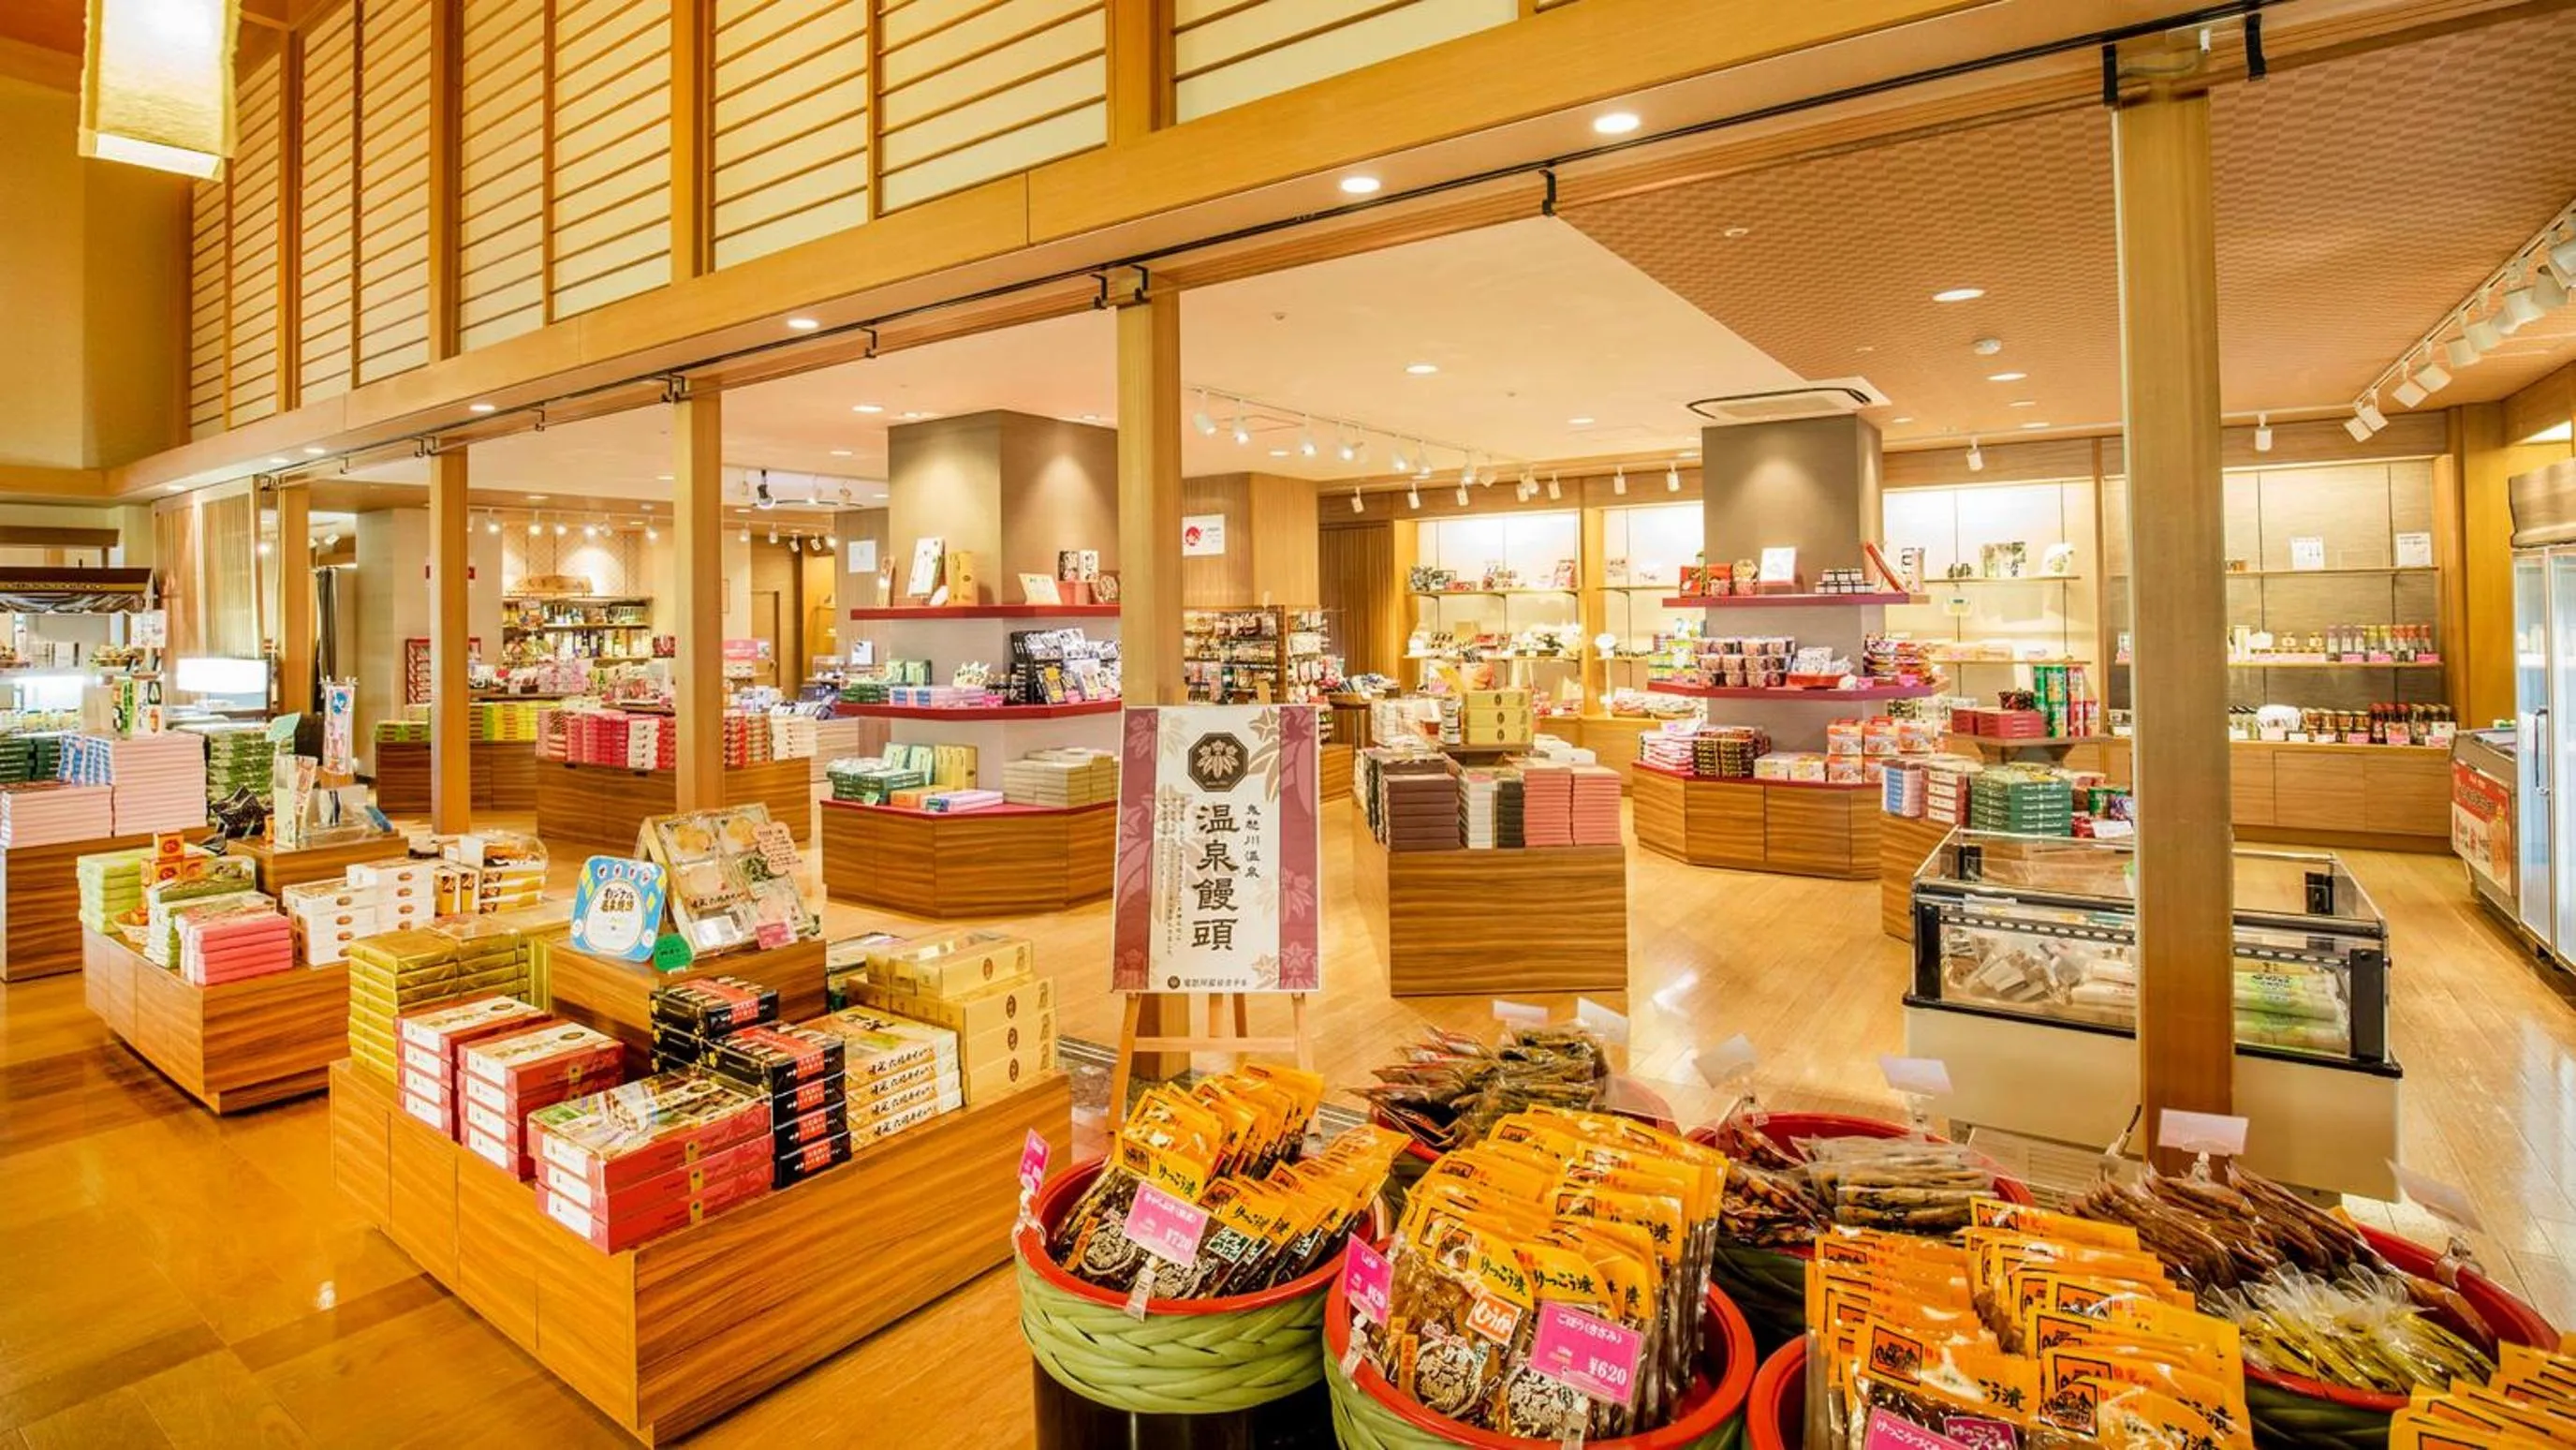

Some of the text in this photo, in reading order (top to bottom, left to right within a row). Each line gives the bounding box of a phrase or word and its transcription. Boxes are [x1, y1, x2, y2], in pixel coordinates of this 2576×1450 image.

[1244, 803, 1261, 879] 鬼怒川温泉
[1191, 804, 1241, 952] 温泉饅頭
[1480, 1254, 1526, 1296] けっこう漬
[1533, 1268, 1596, 1295] けっこう漬
[1587, 1355, 1627, 1386] ¥620
